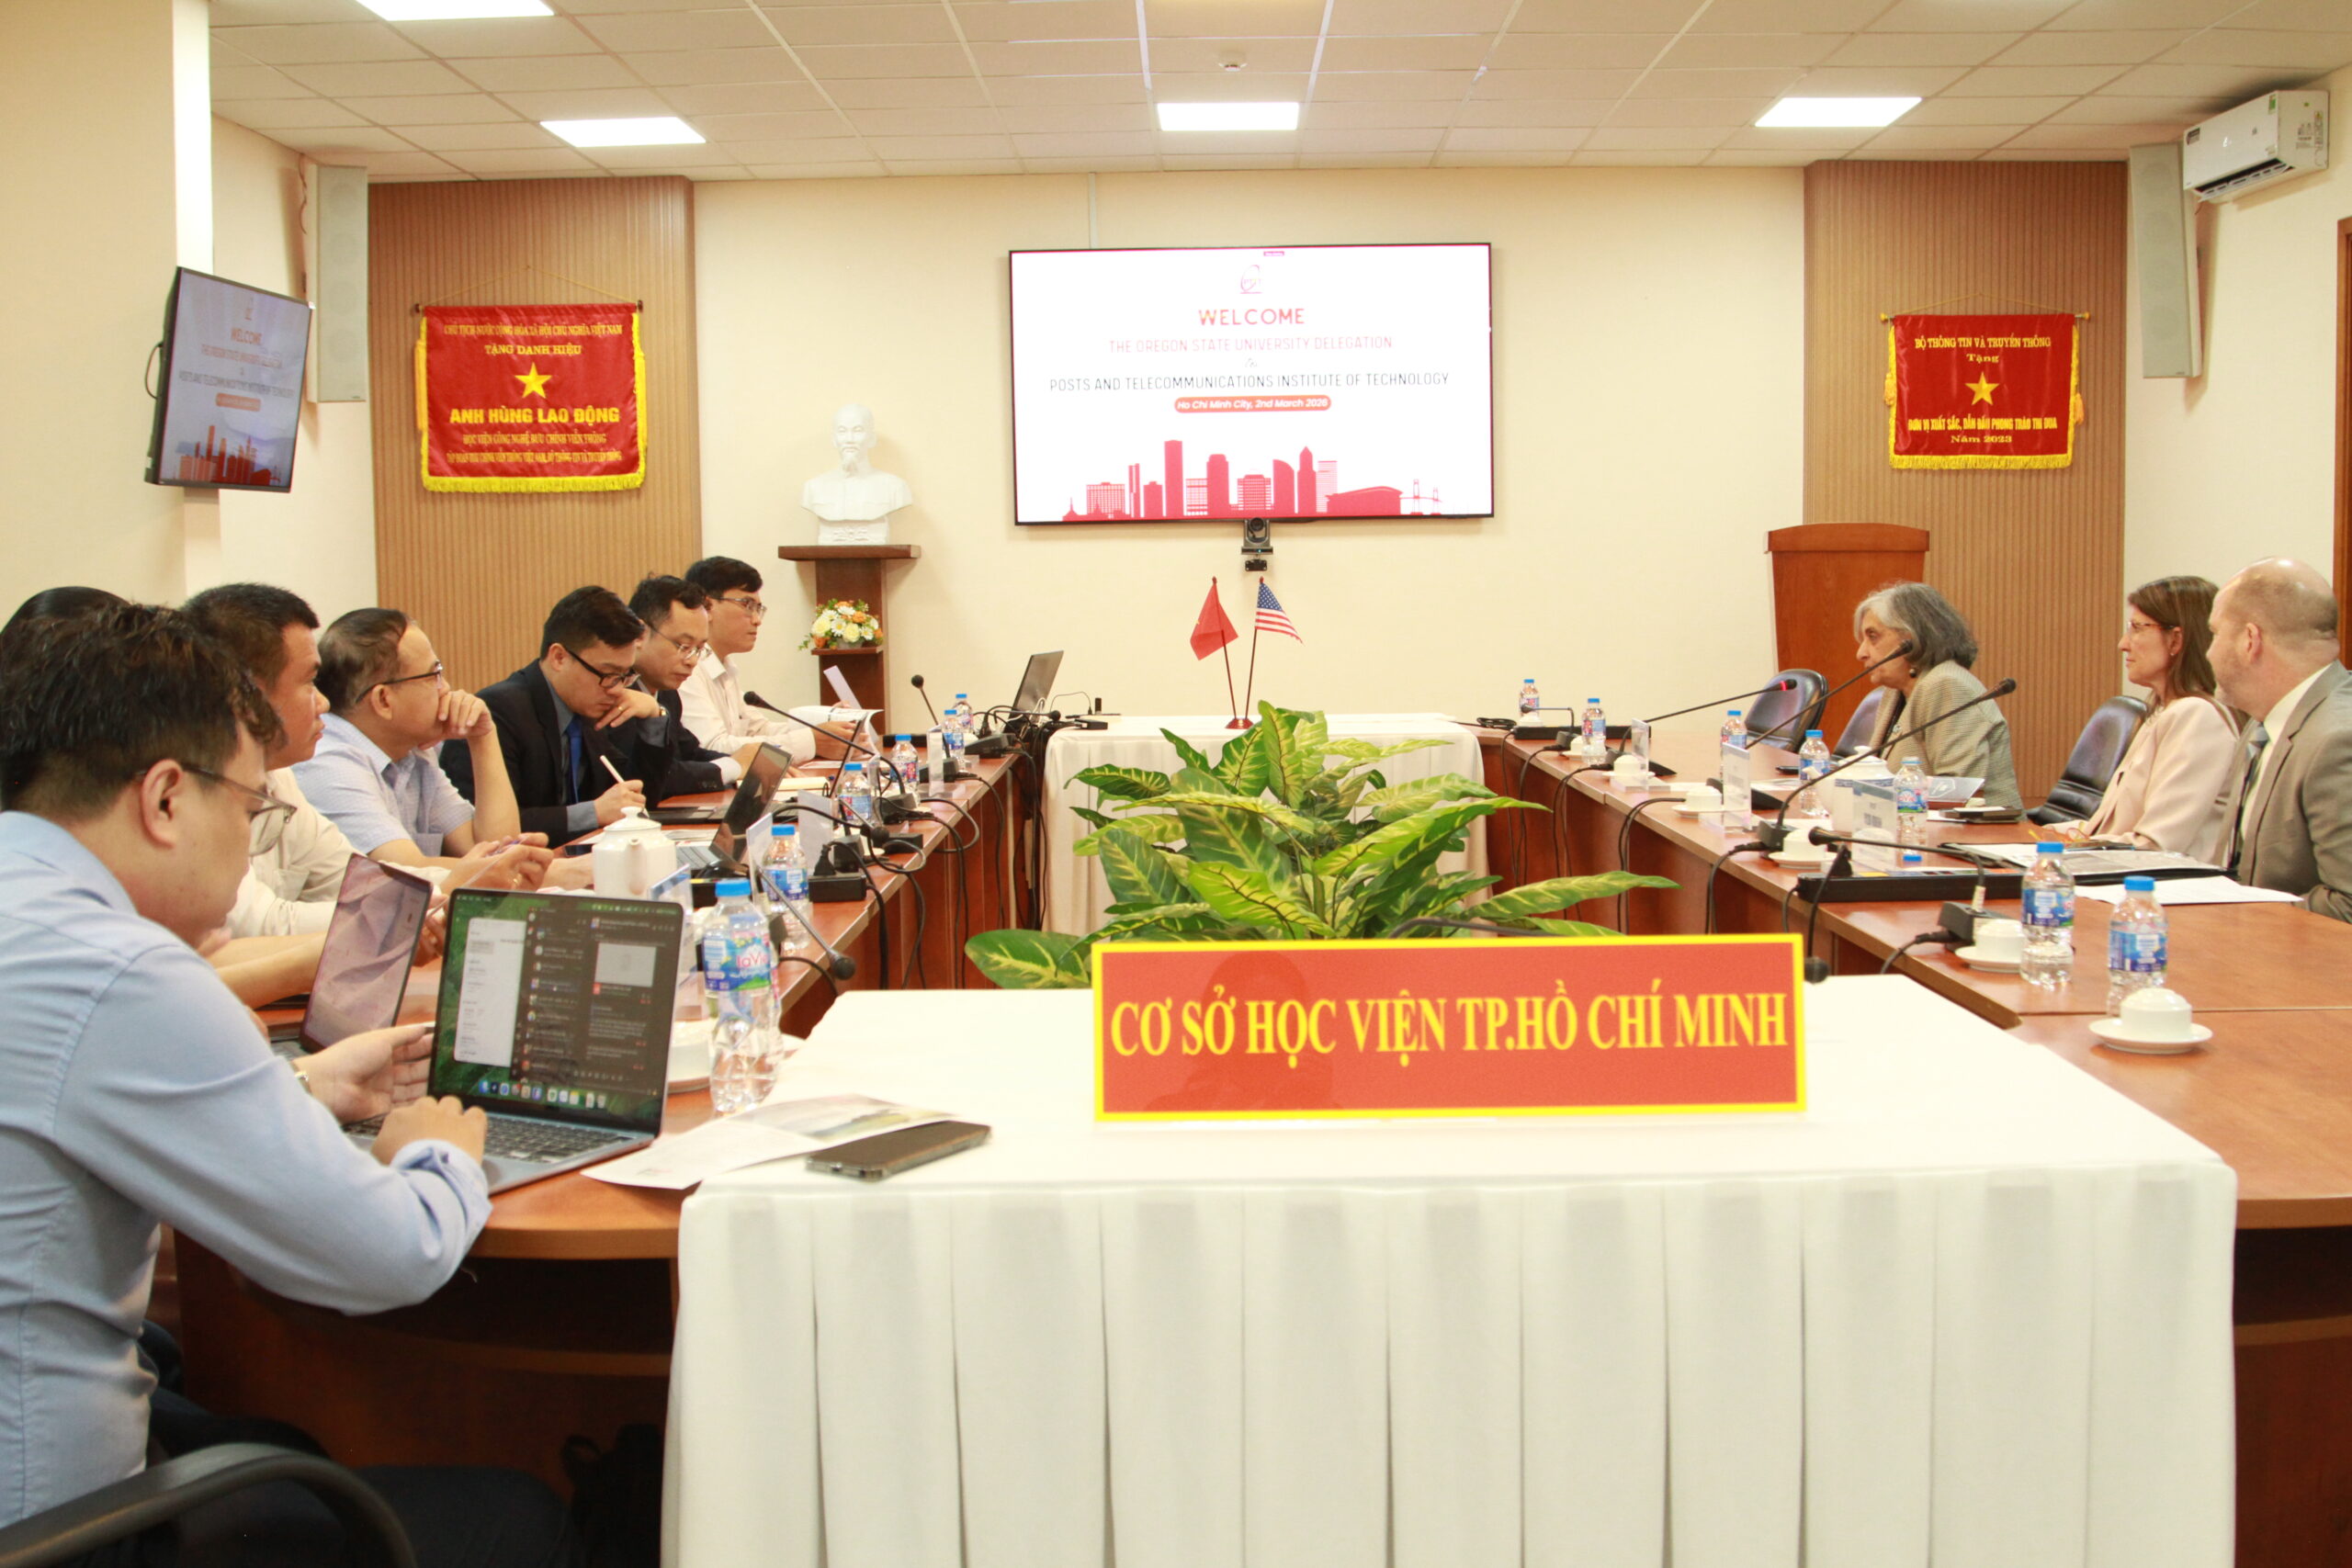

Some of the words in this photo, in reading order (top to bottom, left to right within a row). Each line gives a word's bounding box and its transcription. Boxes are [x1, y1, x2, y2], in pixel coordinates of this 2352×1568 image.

[1198, 308, 1305, 325] WELCOME
[517, 344, 549, 355] DANH
[553, 342, 582, 356] HIỆU
[1110, 340, 1131, 353] THE
[1136, 339, 1187, 353] OREGON
[1192, 338, 1230, 352] STATE
[1236, 337, 1310, 351] UNIVERSITY
[1315, 336, 1392, 350] DELEGATION
[1915, 335, 1927, 351] BỘ
[1928, 334, 1956, 348] THÔNG
[1958, 337, 1973, 347] TIN
[2022, 334, 2052, 347] THÔNG
[1966, 353, 1999, 364] Tặng
[1050, 378, 1091, 391] POSTS
[1095, 378, 1121, 390] AND
[1125, 375, 1273, 390] TELECOMMUNICATIONS
[1277, 373, 1341, 388] INSTITUTE
[1346, 373, 1361, 387] OF
[1366, 372, 1449, 386] TECHNOLOGY
[1177, 400, 1190, 410] Ho
[1193, 400, 1207, 409] Chi
[1209, 400, 1231, 409] Minh
[1255, 400, 1273, 409] 2nd
[1274, 399, 1304, 408] March
[449, 409, 484, 423] ANH
[489, 405, 533, 423] HÙNG
[537, 408, 569, 423] LAO
[573, 405, 619, 426] ĐỘNG
[1111, 998, 1173, 1056] CƠ
[1182, 985, 1237, 1056] SỞ
[1245, 998, 1338, 1069] HỌC
[1346, 989, 1447, 1067] VIỆN
[1456, 978, 1577, 1052] TP.HỒ
[1588, 978, 1665, 1050] CHÍ
[1674, 992, 1790, 1048] MINH
